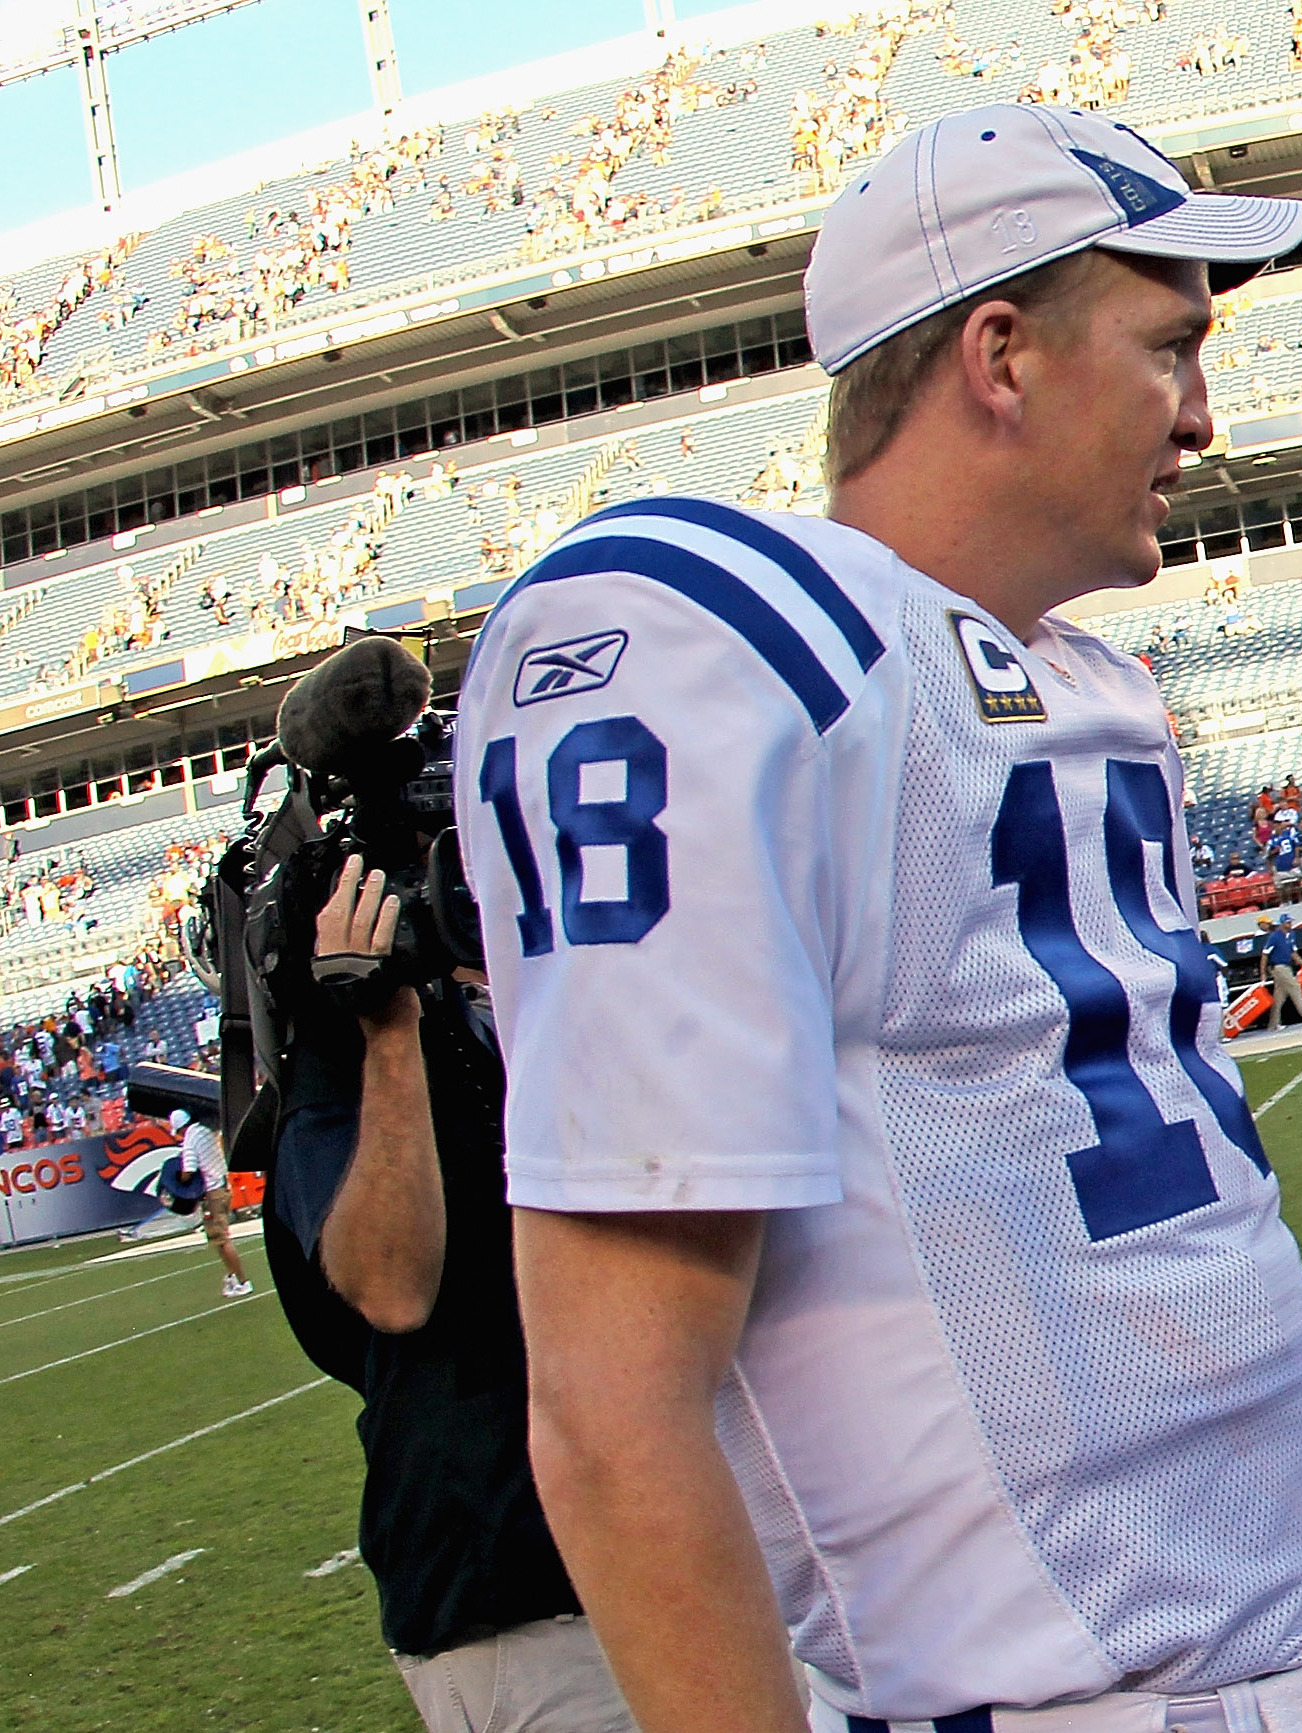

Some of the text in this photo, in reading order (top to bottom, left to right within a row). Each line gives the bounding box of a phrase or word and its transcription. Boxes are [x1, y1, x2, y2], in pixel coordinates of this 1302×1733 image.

[992, 209, 1038, 255] 18
[958, 617, 1029, 693] C
[479, 716, 671, 958] 18
